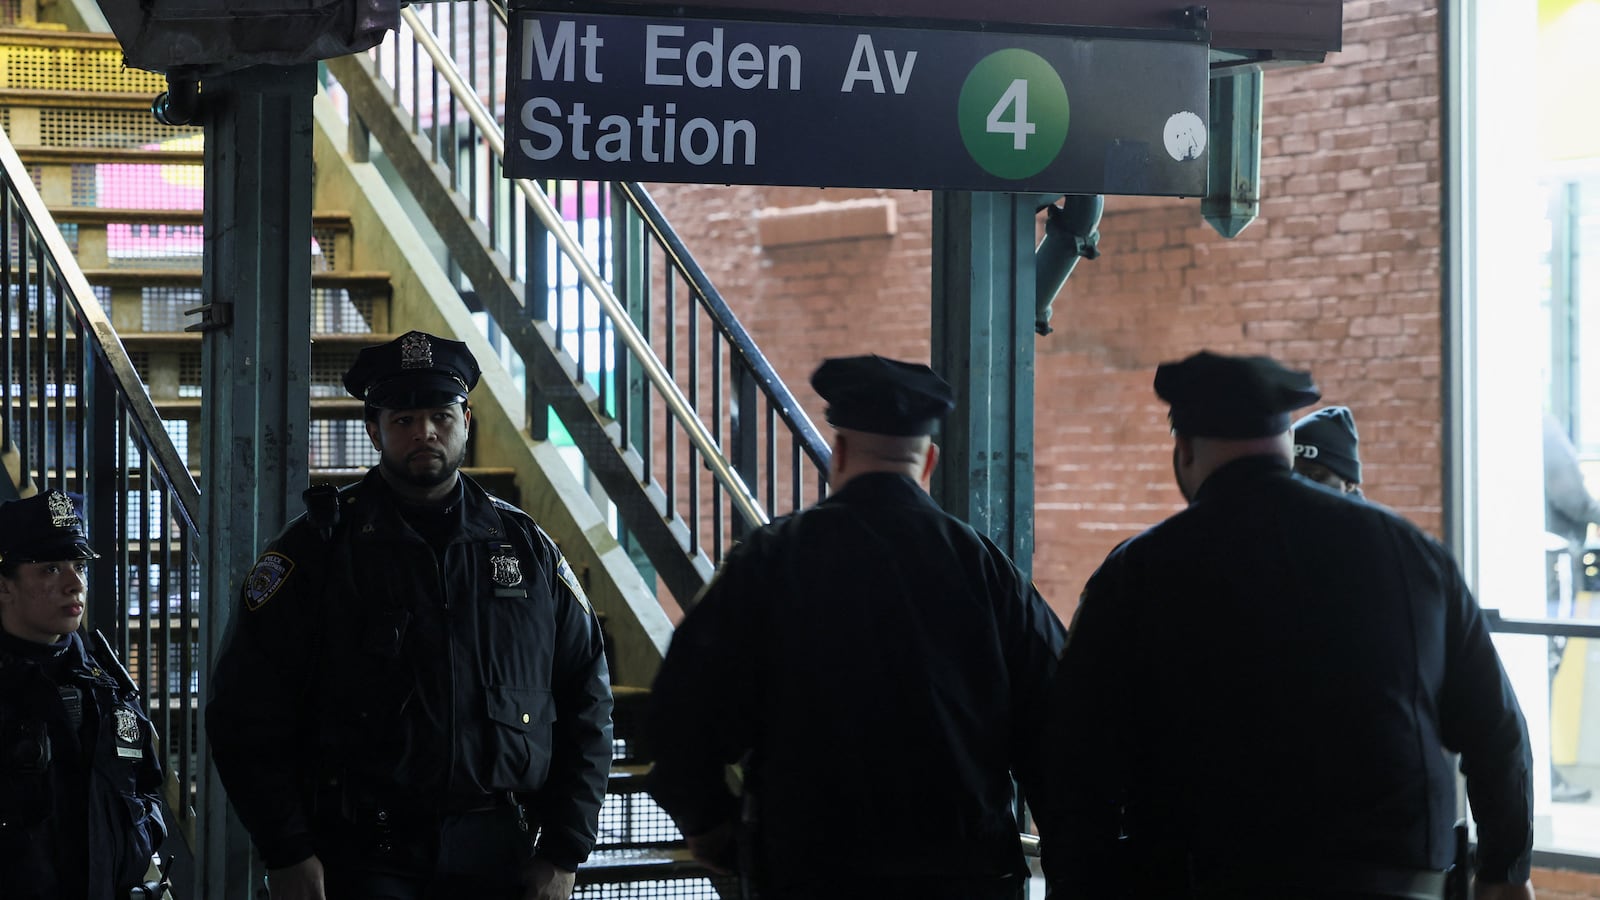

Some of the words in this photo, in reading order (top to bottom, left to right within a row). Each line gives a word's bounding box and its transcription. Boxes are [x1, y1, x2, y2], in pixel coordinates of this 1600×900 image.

[521, 20, 604, 83] Mt
[645, 25, 801, 92] Eden
[841, 35, 918, 95] Av
[519, 97, 757, 166] Station
[986, 78, 1036, 150] 4
